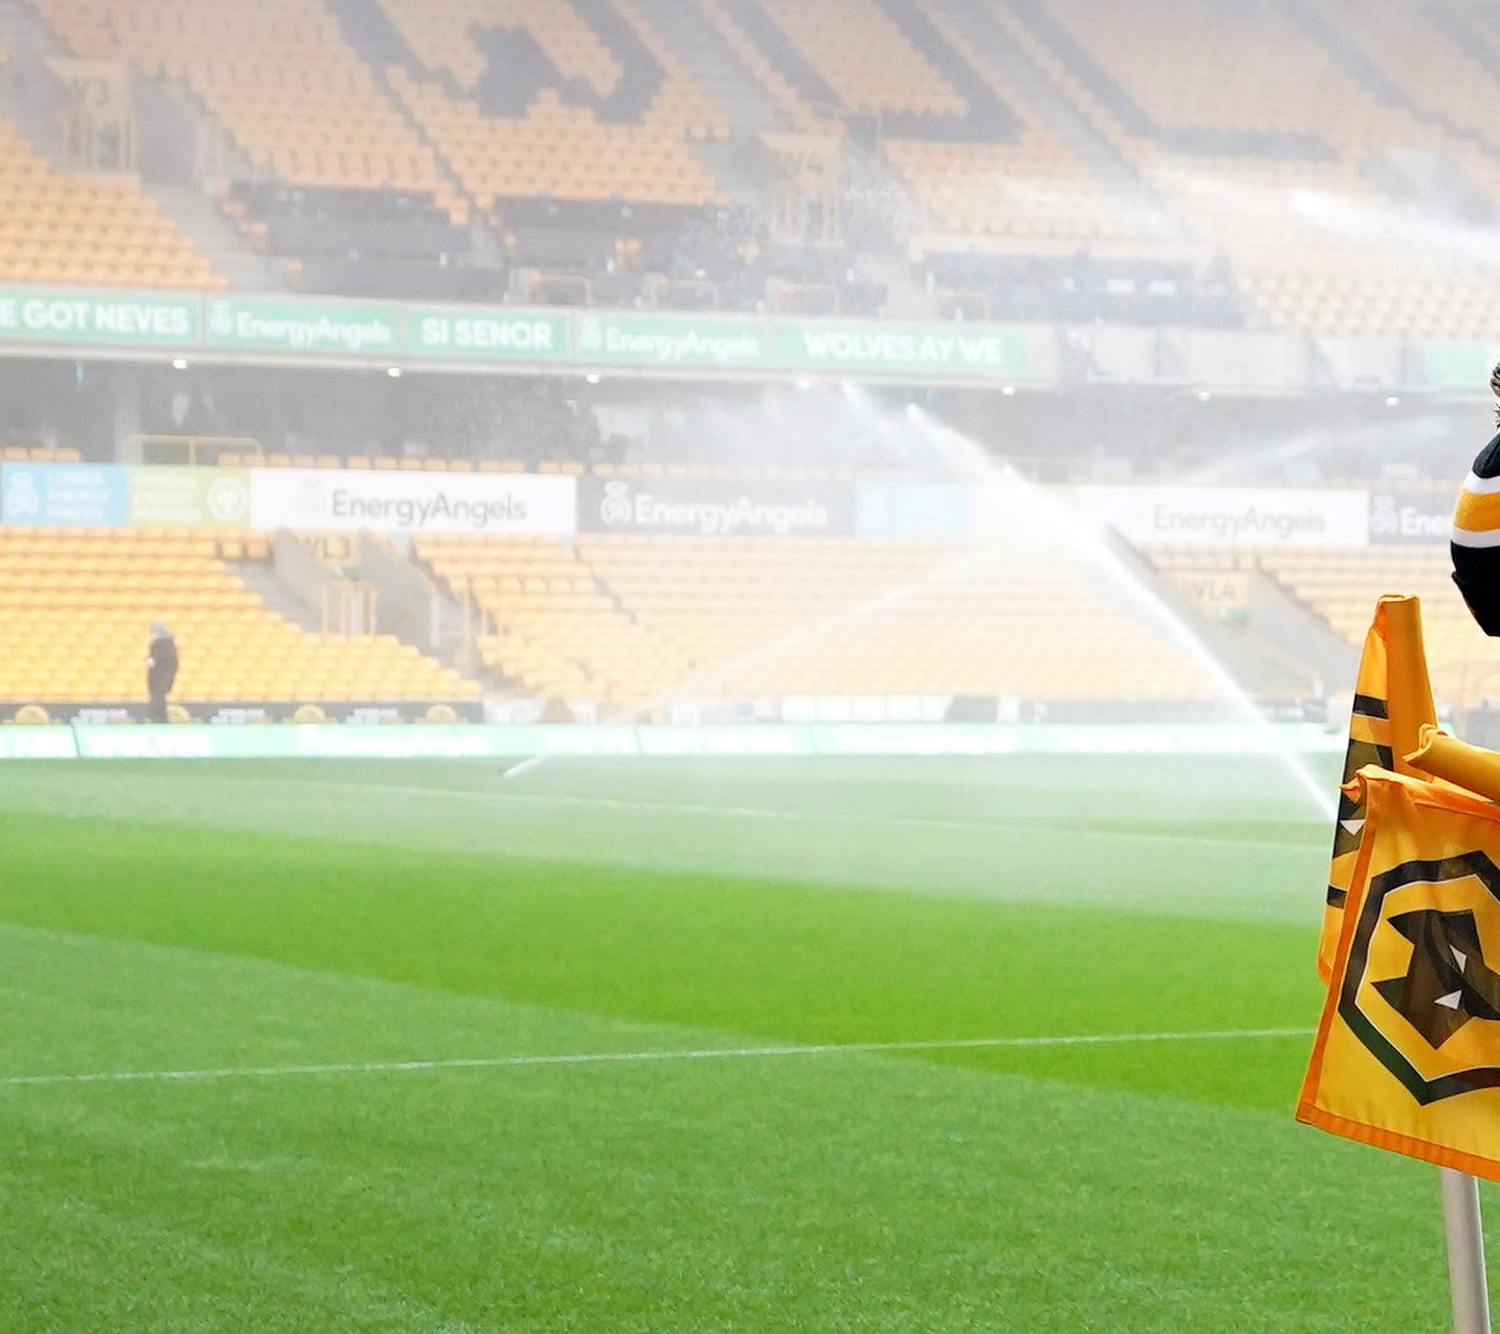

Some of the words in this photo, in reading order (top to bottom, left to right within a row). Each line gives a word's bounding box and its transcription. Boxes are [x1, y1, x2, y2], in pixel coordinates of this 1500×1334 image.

[22, 299, 88, 331] GOT
[95, 303, 190, 336] NEVES
[236, 312, 392, 351] EnergyAngels
[421, 319, 450, 346] SI
[455, 320, 552, 350] SENOR
[605, 327, 759, 362] EnergyAngels
[803, 331, 914, 363] WOLVES
[915, 333, 960, 362] AY
[960, 336, 1002, 363] WE
[331, 489, 527, 526] EnergyAngels
[635, 495, 828, 534] EnergyAngels
[1153, 505, 1327, 540] EnergyAngels
